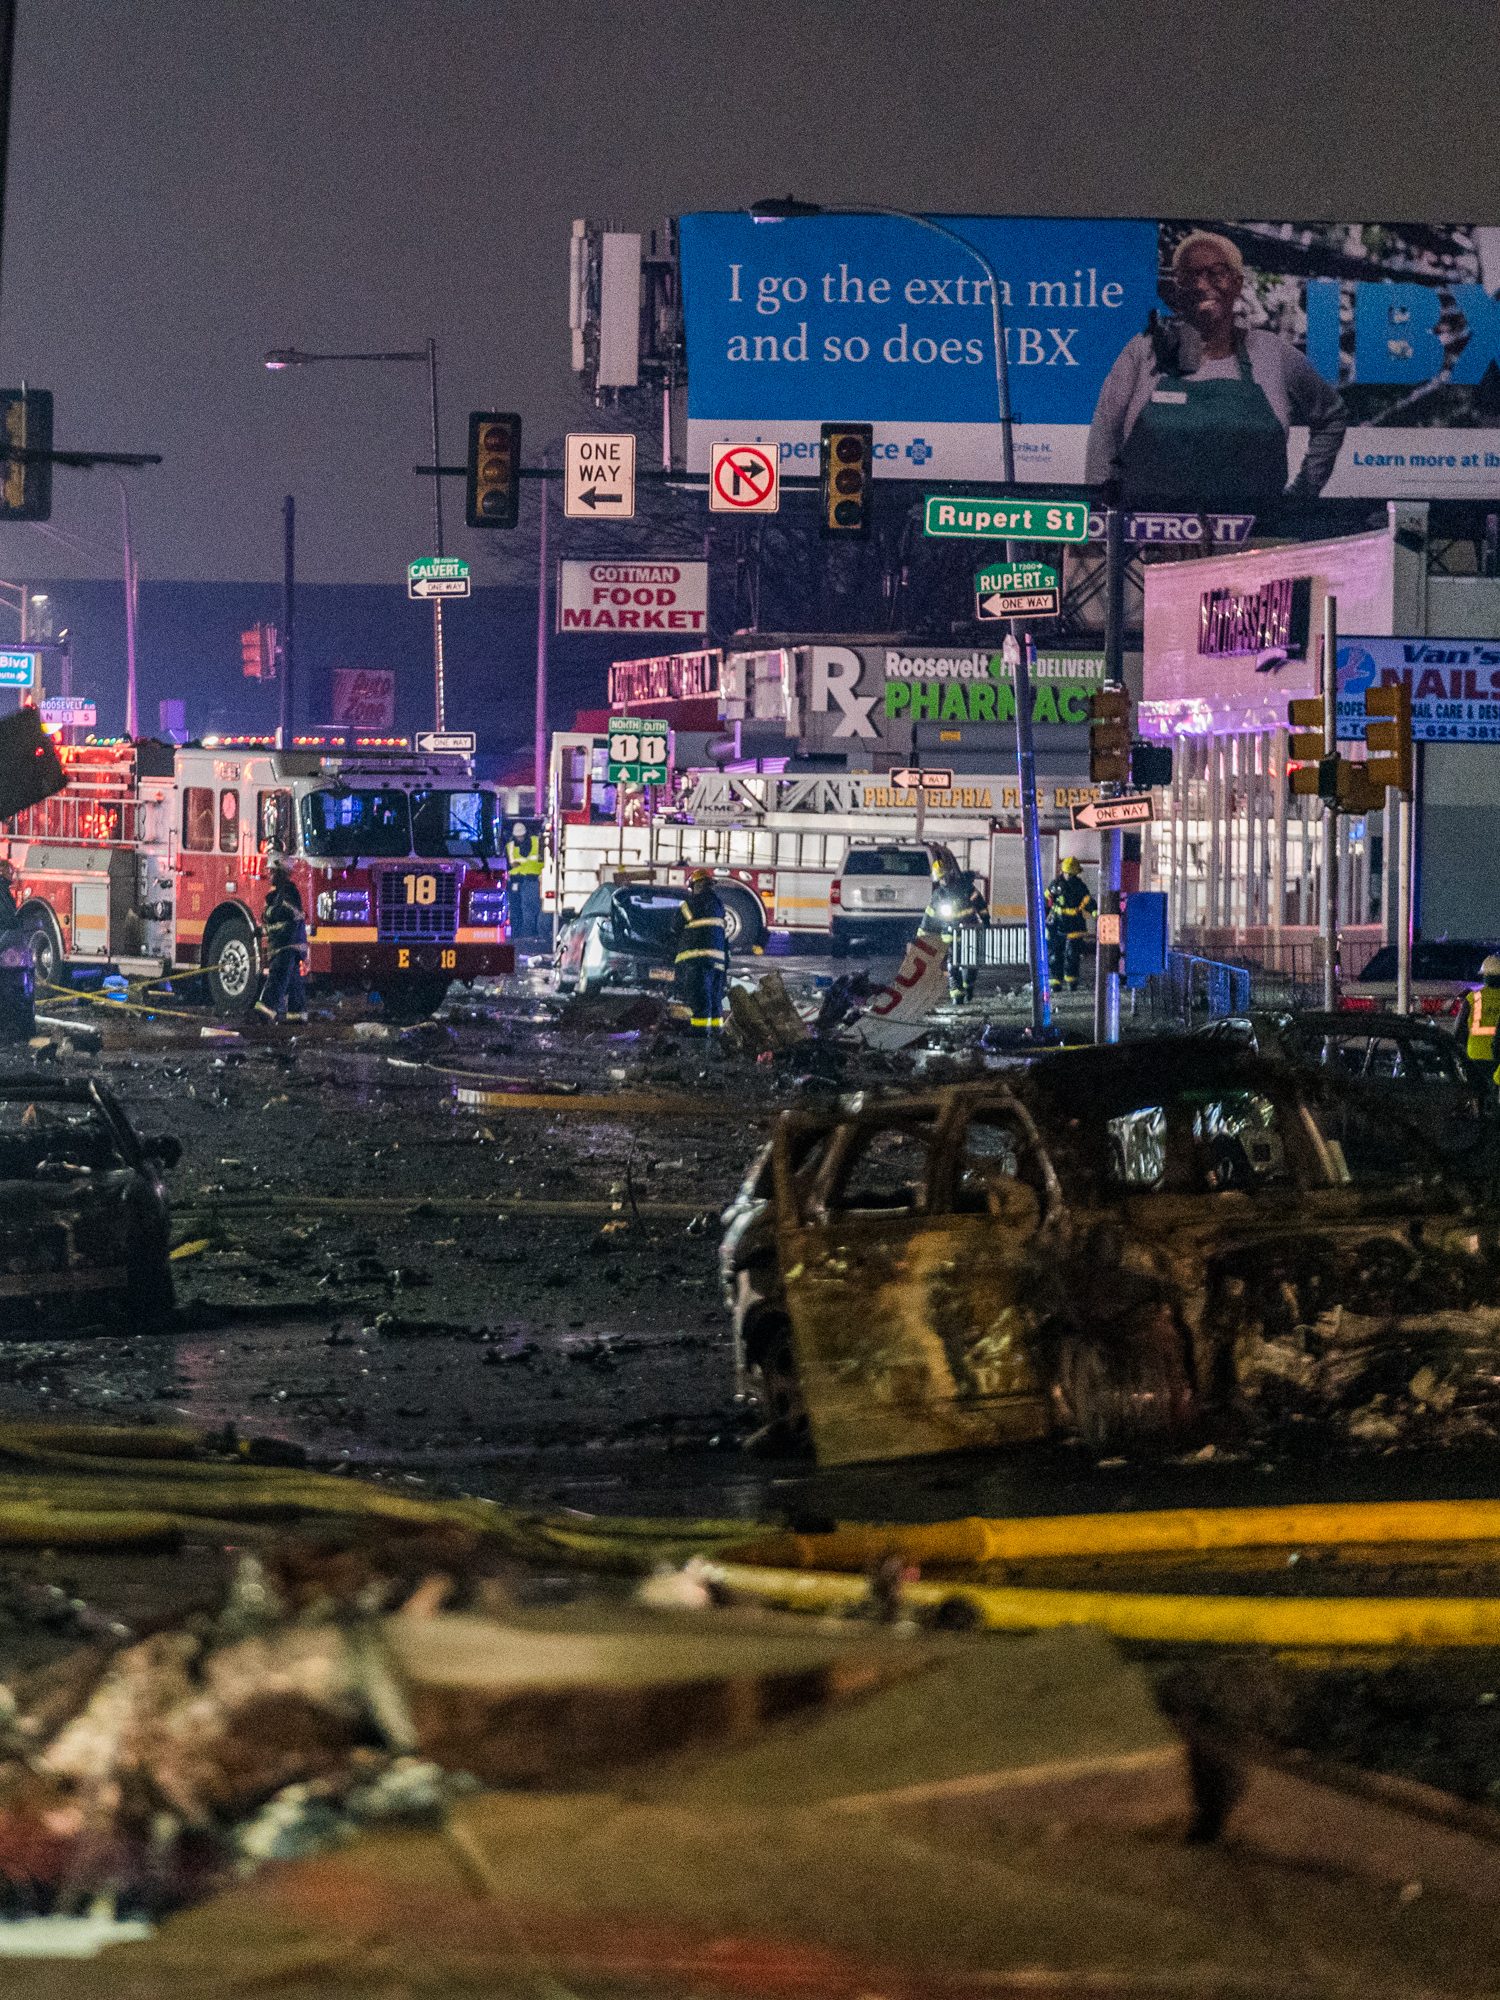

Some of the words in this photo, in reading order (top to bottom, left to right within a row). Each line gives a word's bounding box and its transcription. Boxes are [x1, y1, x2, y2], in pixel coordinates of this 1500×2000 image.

[729, 264, 743, 302] I
[756, 277, 808, 315] go
[822, 264, 891, 303] the
[905, 275, 1013, 306] extra
[1028, 268, 1124, 308] mile
[727, 323, 808, 362] and
[823, 337, 870, 362] so
[883, 324, 983, 364] does
[580, 443, 620, 460] ONE
[1353, 451, 1405, 466] Learn
[1410, 455, 1456, 467] more
[1462, 454, 1479, 467] at
[579, 465, 621, 482] WAY
[939, 505, 1032, 531] Rupert
[1046, 509, 1075, 531] St
[410, 564, 459, 577] CALVERT
[594, 567, 674, 582] COTTMAN
[980, 572, 1042, 591] RUPERT
[1044, 576, 1055, 586] ST
[593, 587, 677, 606] FOOD
[1002, 599, 1023, 609] ONE
[1027, 597, 1049, 607] WAY
[563, 609, 705, 629] MARKET
[0, 655, 28, 668] Blvd
[885, 652, 989, 678] Roosevelt
[1037, 658, 1104, 678] DELIVERY
[811, 646, 878, 737] Rx
[41, 701, 83, 710] ROOSEVELT
[885, 681, 1097, 723] PHARMAC
[1436, 703, 1462, 718] CARE
[46, 713, 53, 721] N
[611, 720, 640, 730] NORTH
[643, 723, 666, 731] OUTH
[620, 739, 627, 757] 1
[647, 741, 654, 758] 1
[928, 775, 944, 783] WAY
[1096, 806, 1119, 820] ONE
[1121, 804, 1144, 817] WAY
[404, 874, 436, 905] 18
[398, 949, 410, 969] E
[441, 949, 456, 969] 18
